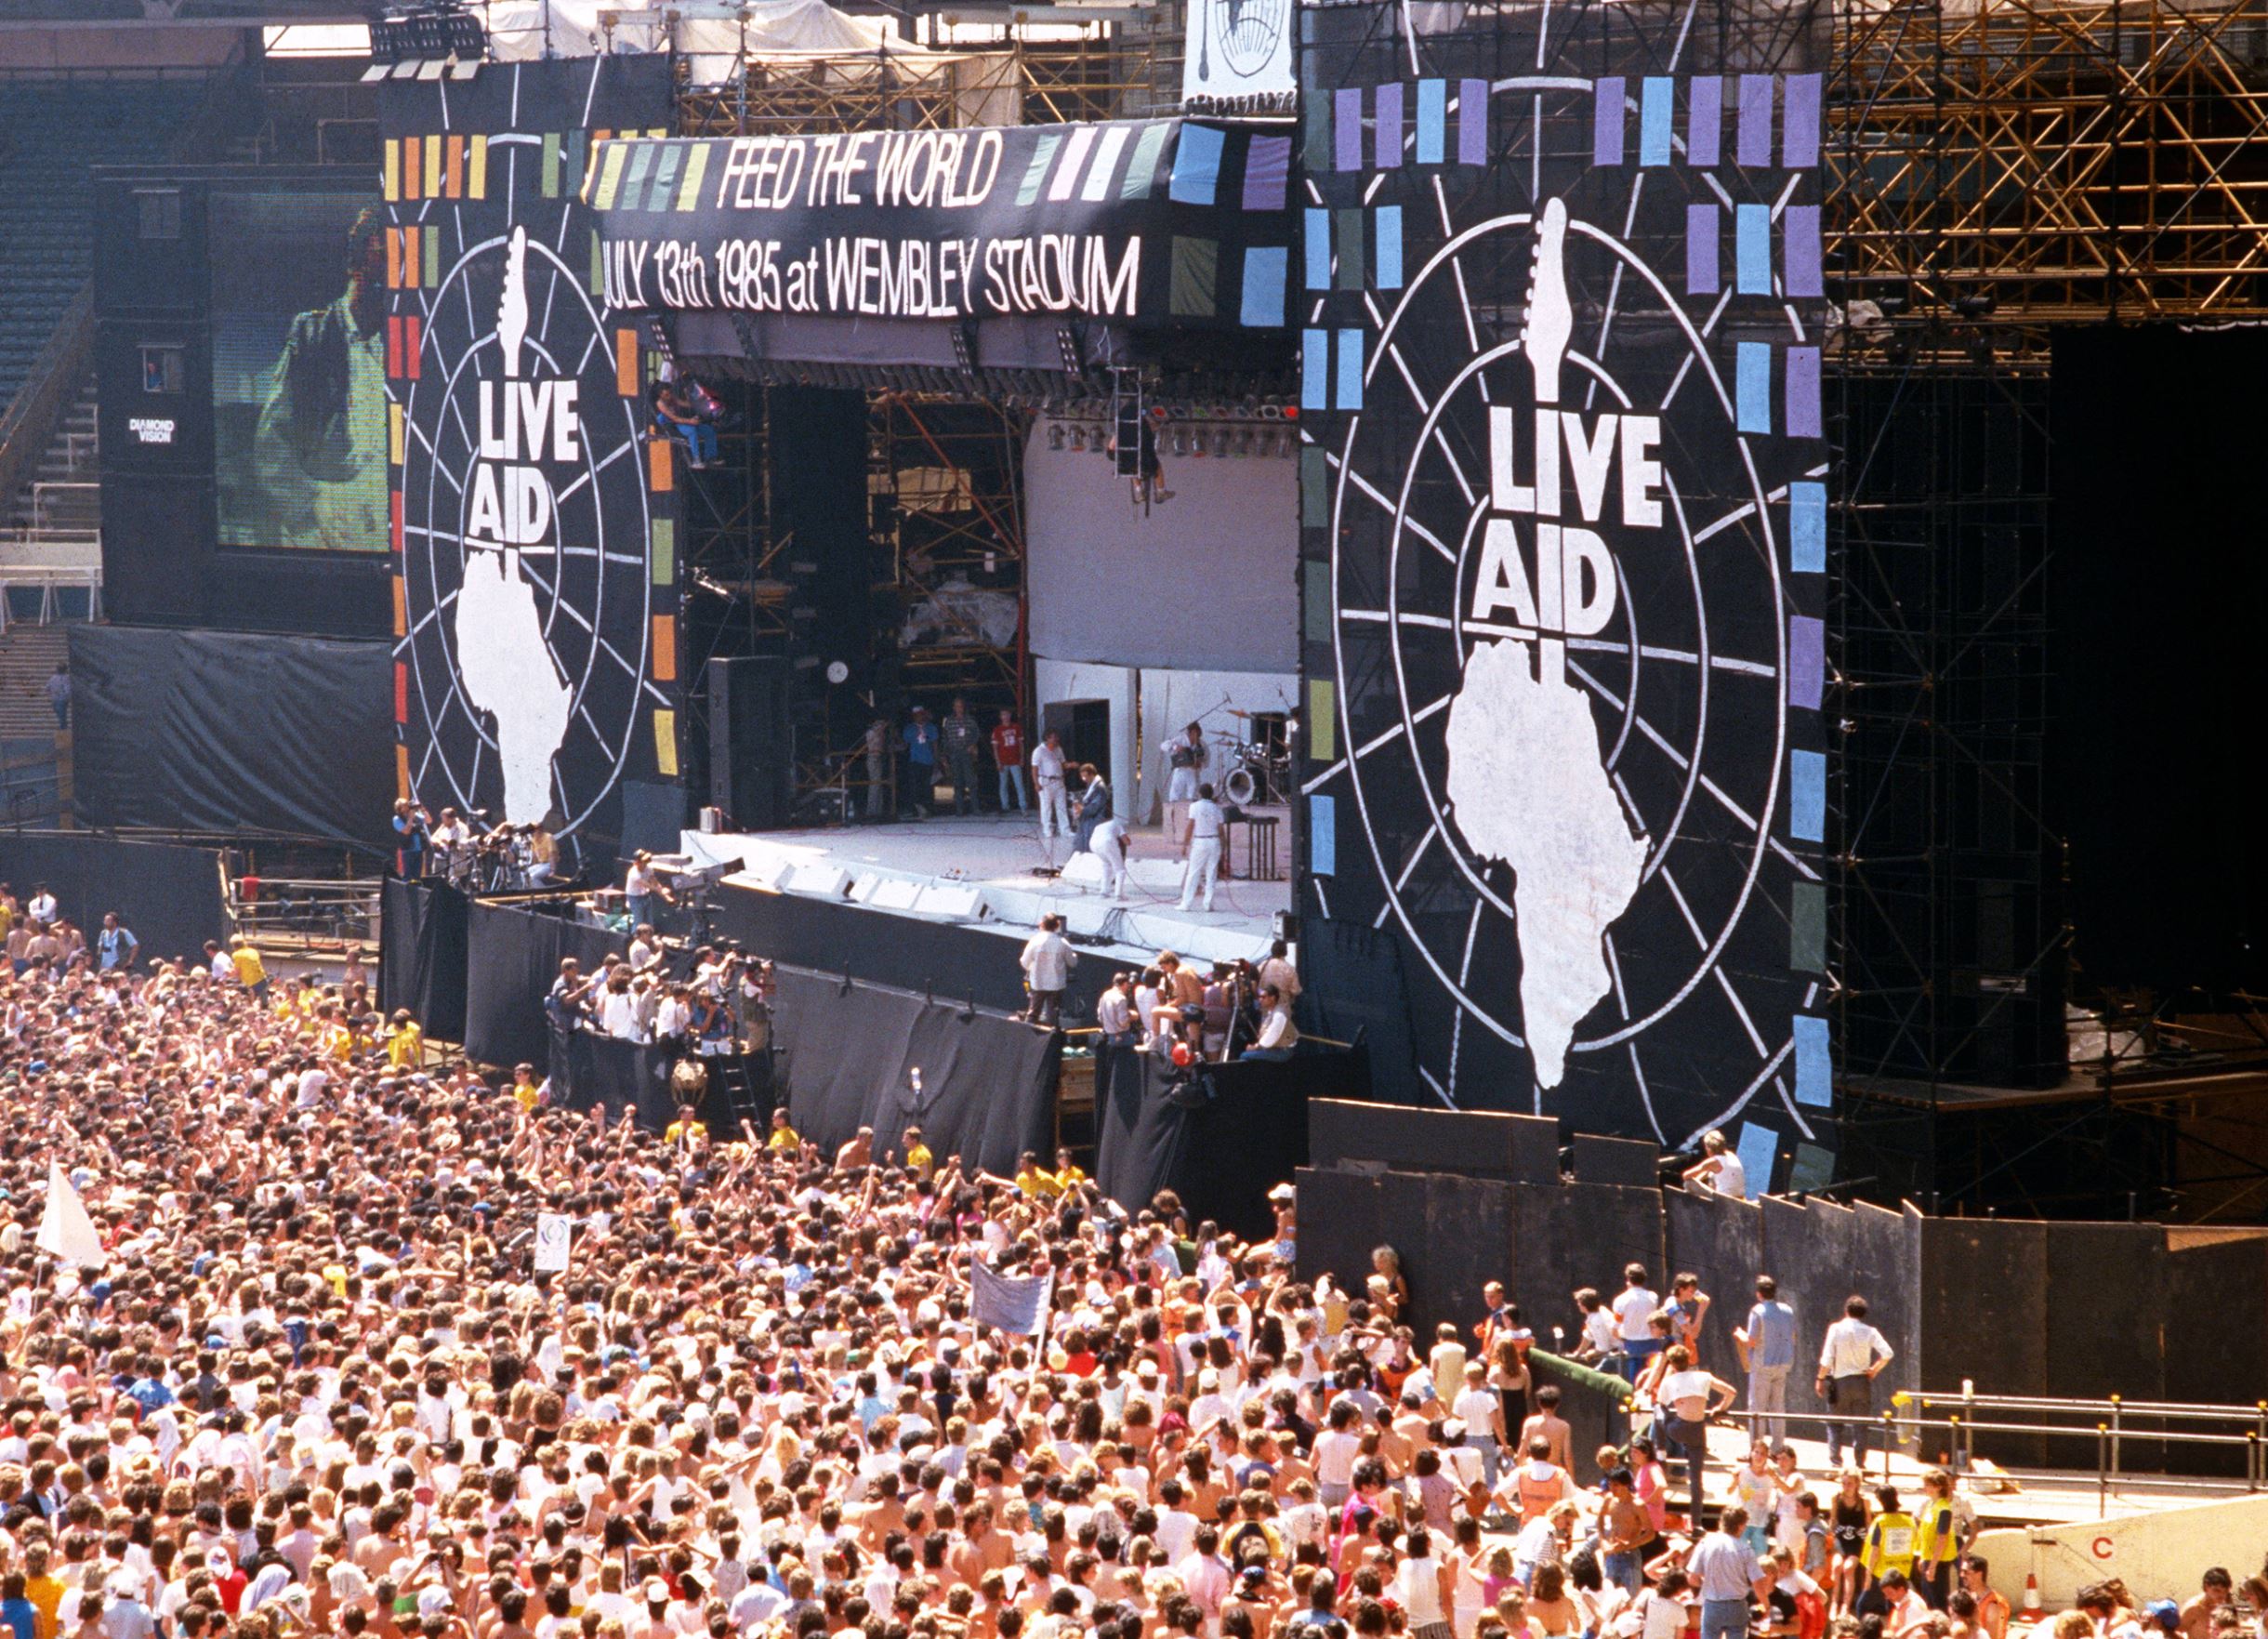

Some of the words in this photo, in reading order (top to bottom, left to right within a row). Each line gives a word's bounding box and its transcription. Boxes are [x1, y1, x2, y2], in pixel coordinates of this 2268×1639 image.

[716, 138, 806, 210] FEED
[806, 132, 876, 207] THE
[876, 129, 1003, 208] WORLD
[653, 240, 715, 309] 13th
[714, 238, 782, 311] 1985
[786, 245, 821, 312] at
[825, 235, 980, 317] WEMBLEY
[129, 417, 175, 433] DIAMOND
[138, 430, 172, 443] VISION
[479, 379, 579, 462] LIVE
[468, 463, 551, 544] AID
[1489, 405, 1663, 527] LIVE
[1471, 519, 1617, 636] AID
[2092, 1536, 2113, 1560] C
